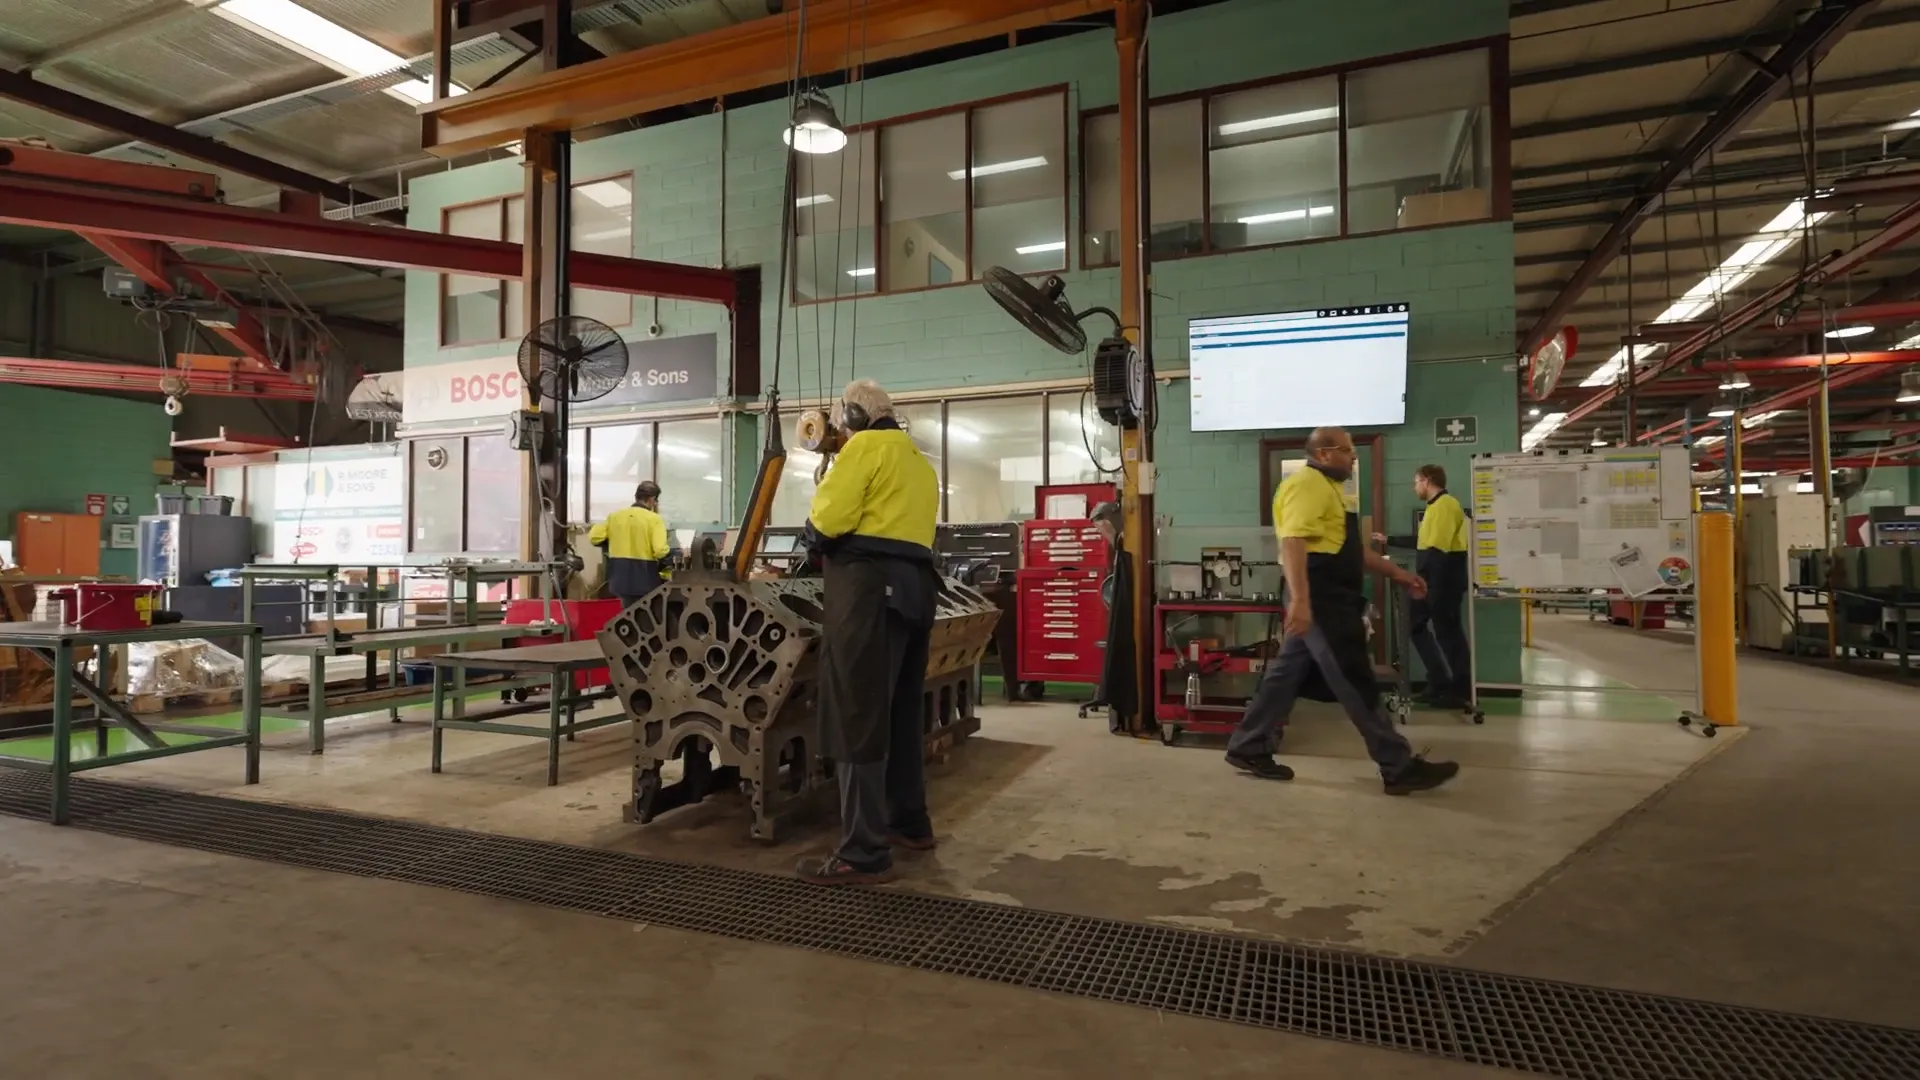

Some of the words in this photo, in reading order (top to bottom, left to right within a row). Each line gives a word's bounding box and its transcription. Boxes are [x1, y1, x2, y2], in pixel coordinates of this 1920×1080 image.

[631, 371, 643, 388] &
[647, 369, 689, 386] Sons
[451, 371, 519, 403] BOSC
[347, 468, 387, 480] MOORE
[347, 482, 376, 493] SONS
